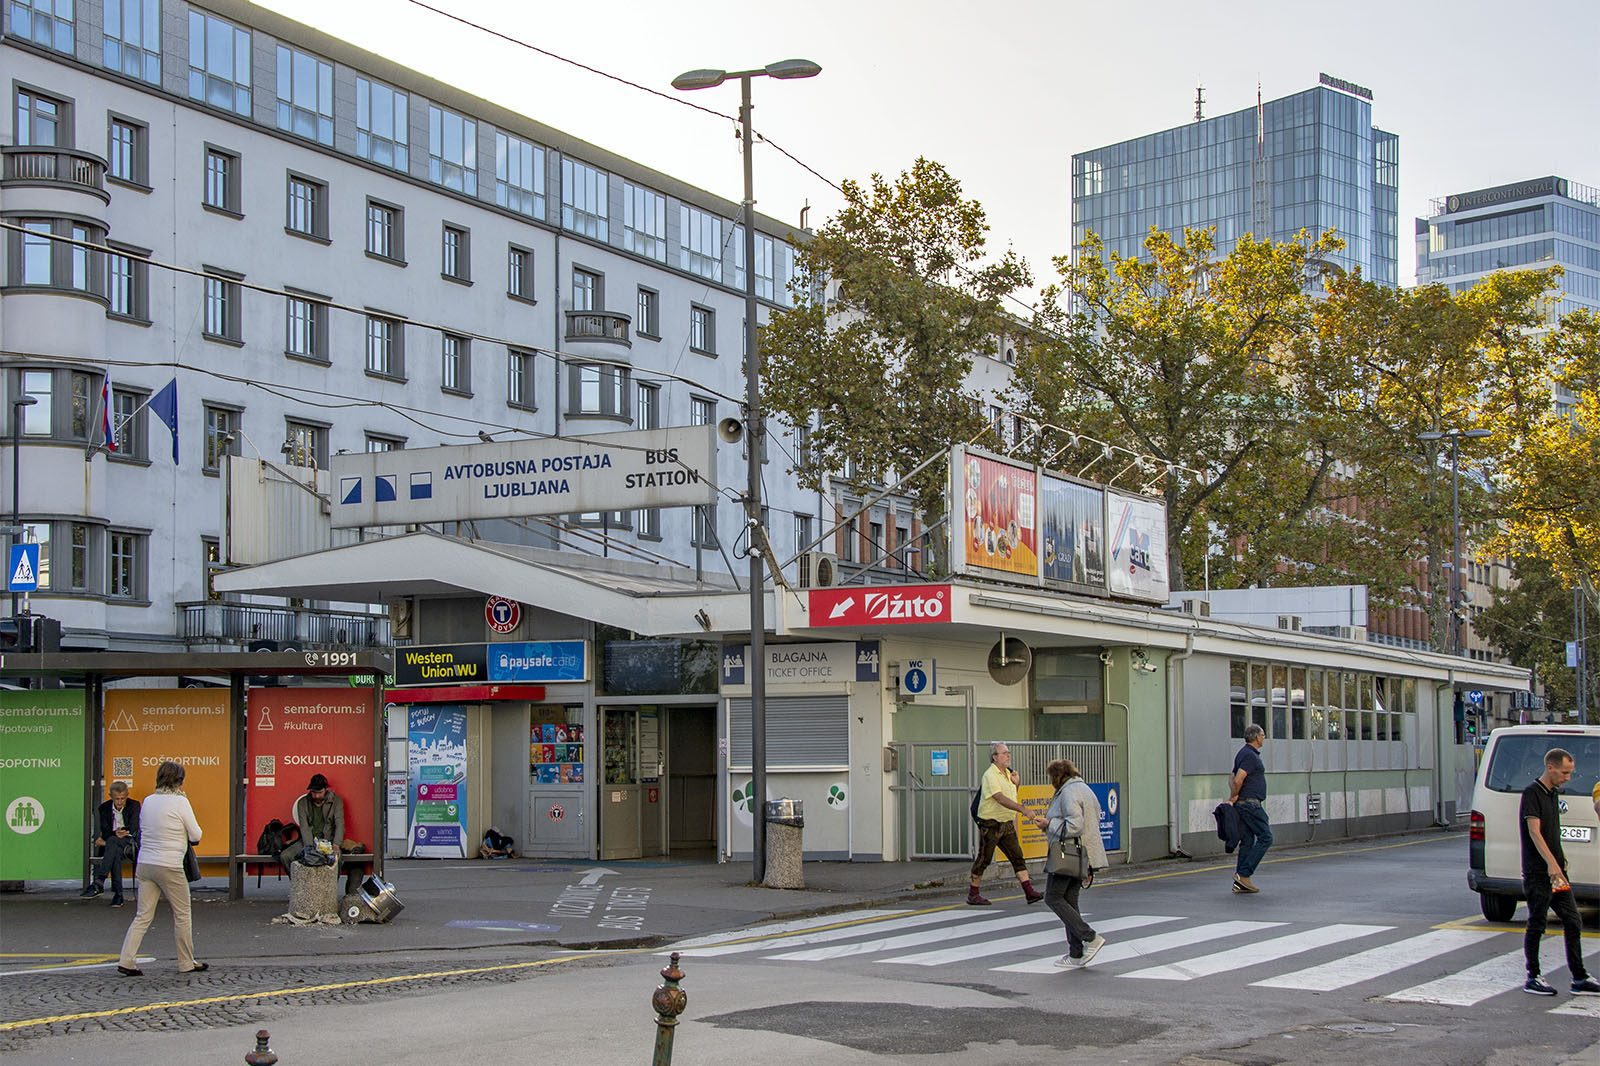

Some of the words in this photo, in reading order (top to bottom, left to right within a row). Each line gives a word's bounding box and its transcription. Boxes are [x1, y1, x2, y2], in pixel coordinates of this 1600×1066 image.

[645, 448, 678, 465] BUS
[443, 460, 537, 480] AVTOBUSNA
[541, 454, 612, 473] POSTAJA
[625, 469, 699, 488] STATION
[484, 479, 570, 498] LJUBLJANA
[496, 605, 508, 622] T
[321, 652, 357, 666] 1991
[405, 652, 454, 665] Western
[509, 654, 576, 670] paysafecard
[772, 651, 828, 663] BLAGAJNA
[909, 660, 923, 668] WC
[421, 665, 454, 678] Union
[457, 664, 477, 677] WU
[768, 667, 797, 678] TICKET
[800, 666, 832, 677] OFFICE
[0, 705, 82, 716] semaforum.si
[142, 703, 225, 715] semaforum.si
[283, 703, 366, 715] semaforum.si
[142, 721, 175, 733] #šport
[283, 721, 323, 731] #kultura
[0, 758, 61, 768] SOPOTNIKI
[142, 754, 220, 767] SOŠPORTNIKI
[283, 755, 367, 766] SOKULTURNIKI
[1560, 829, 1588, 839] 2-CBT
[597, 914, 645, 931] BUS
